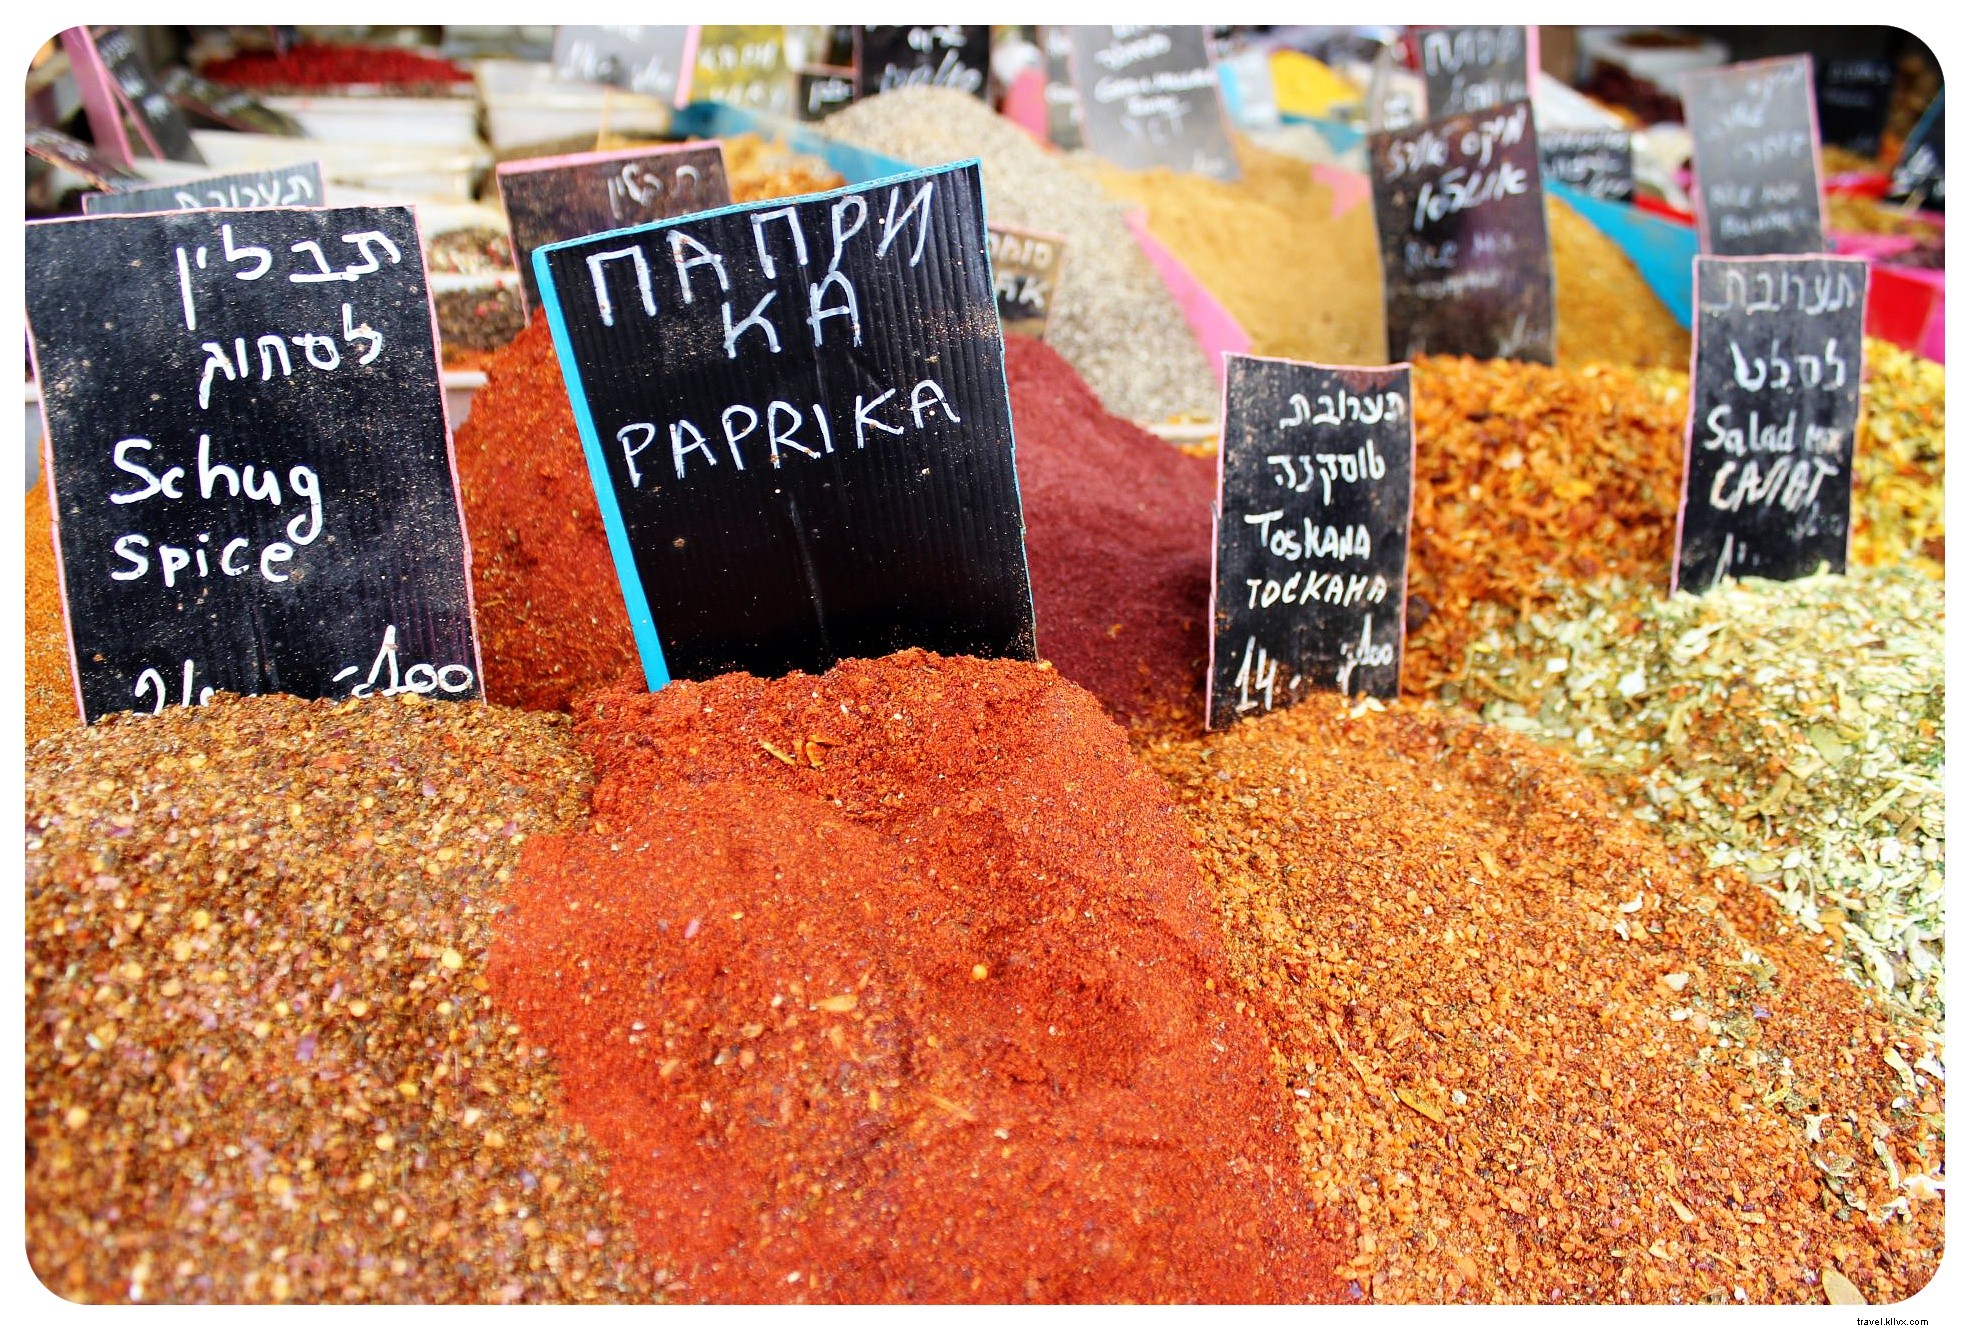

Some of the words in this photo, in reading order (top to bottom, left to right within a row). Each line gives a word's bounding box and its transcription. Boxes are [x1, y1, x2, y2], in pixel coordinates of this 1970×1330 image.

[176, 223, 401, 331] תבלין
[586, 181, 934, 327] ПАПРИ
[1701, 266, 1856, 318] תערובת
[722, 271, 861, 358] КА
[1728, 336, 1847, 391] לסלט
[617, 380, 960, 487] PAPRIKA
[1279, 389, 1406, 429] תערובת
[1704, 404, 1798, 457] Salad
[110, 434, 322, 545] Schug
[1267, 439, 1386, 505] טוסקנה
